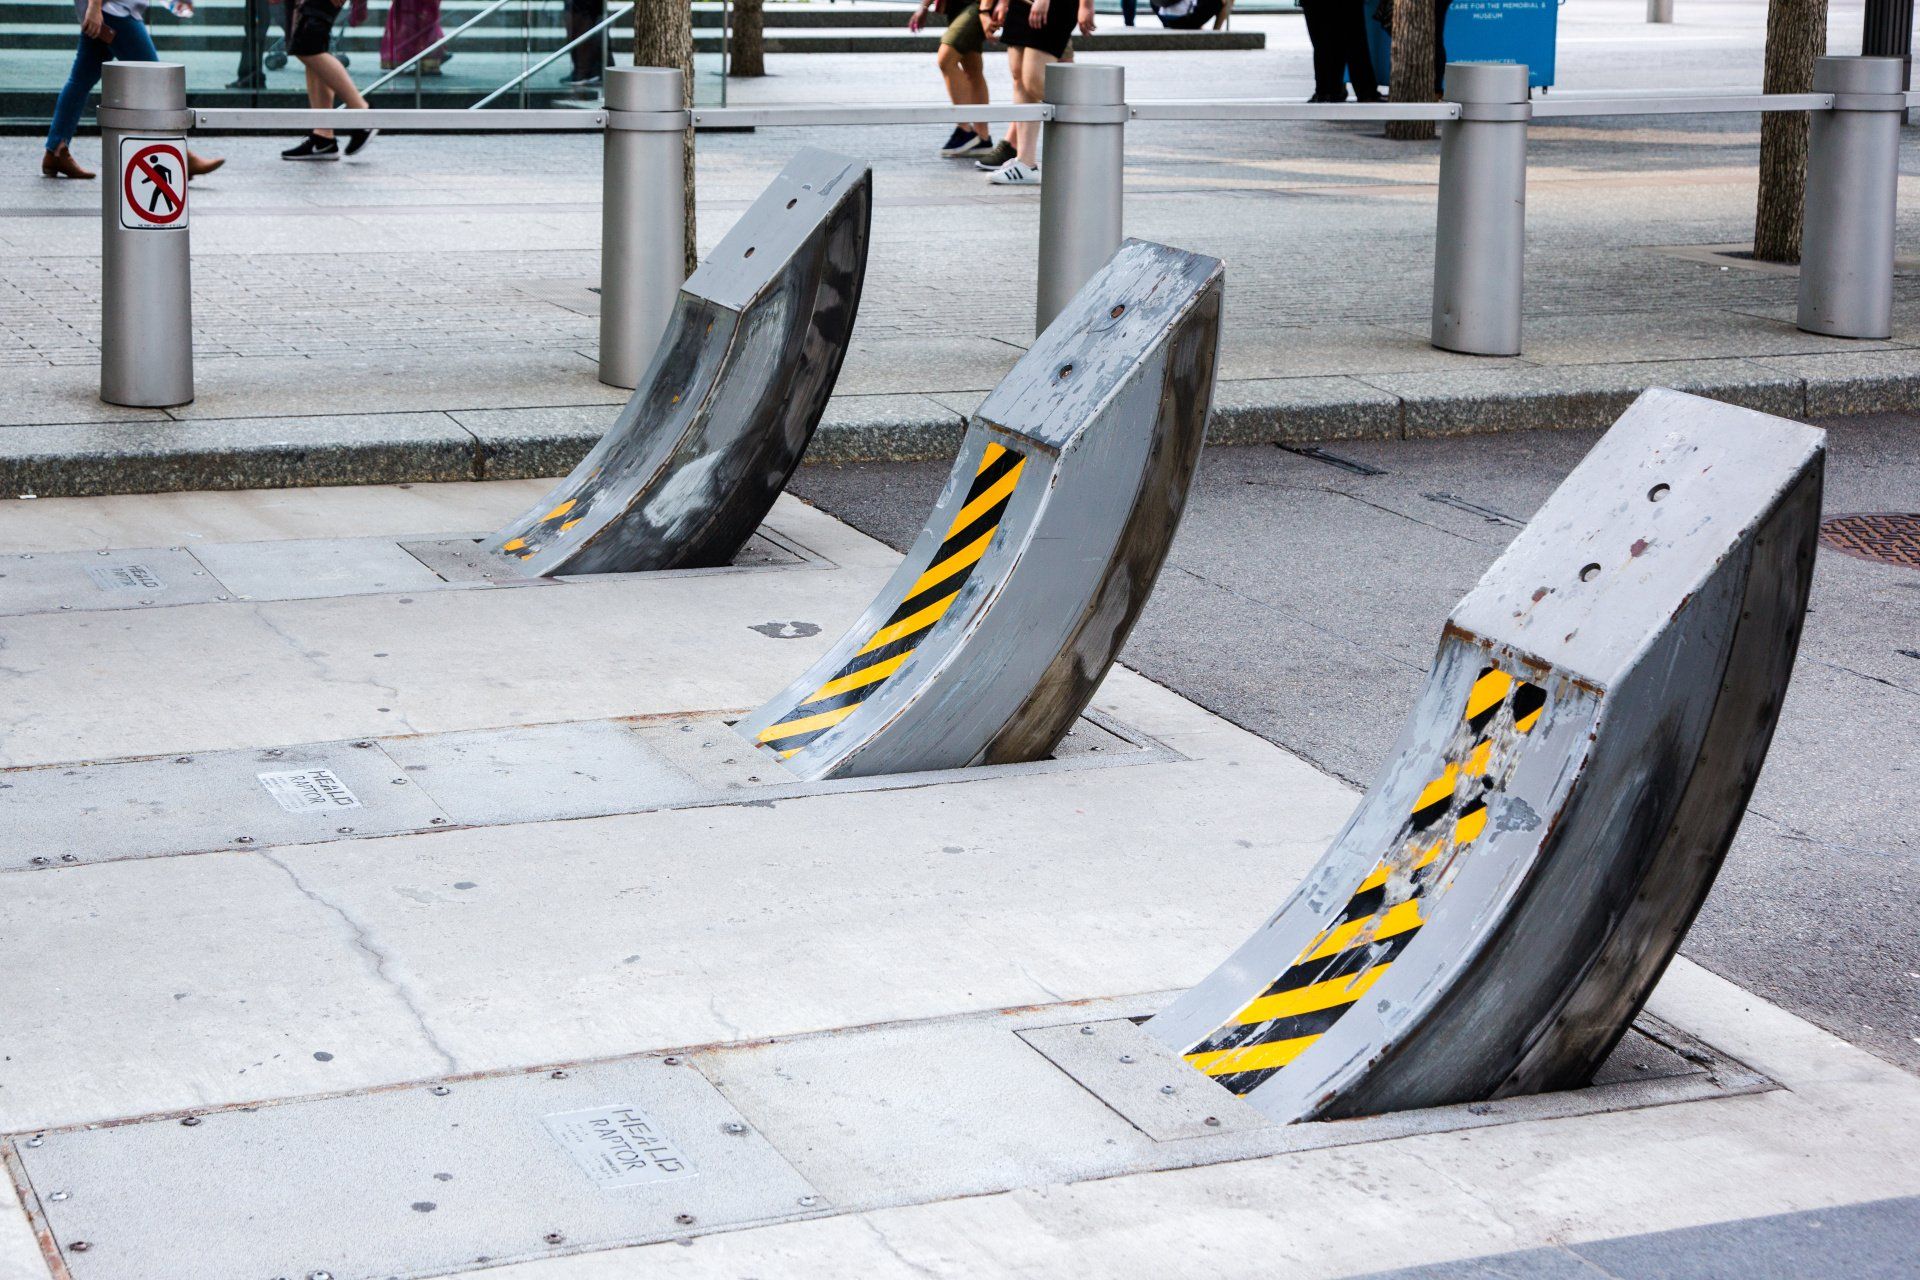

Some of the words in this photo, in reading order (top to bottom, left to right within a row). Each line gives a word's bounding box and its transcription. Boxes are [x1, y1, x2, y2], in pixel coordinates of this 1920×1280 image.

[1450, 2, 1468, 10] CARE
[1470, 2, 1485, 10] FOR
[288, 775, 326, 804] RAPTOR
[307, 770, 354, 806] HEALD
[589, 1118, 647, 1171] RAPTOR
[612, 1109, 685, 1172] HEALD
